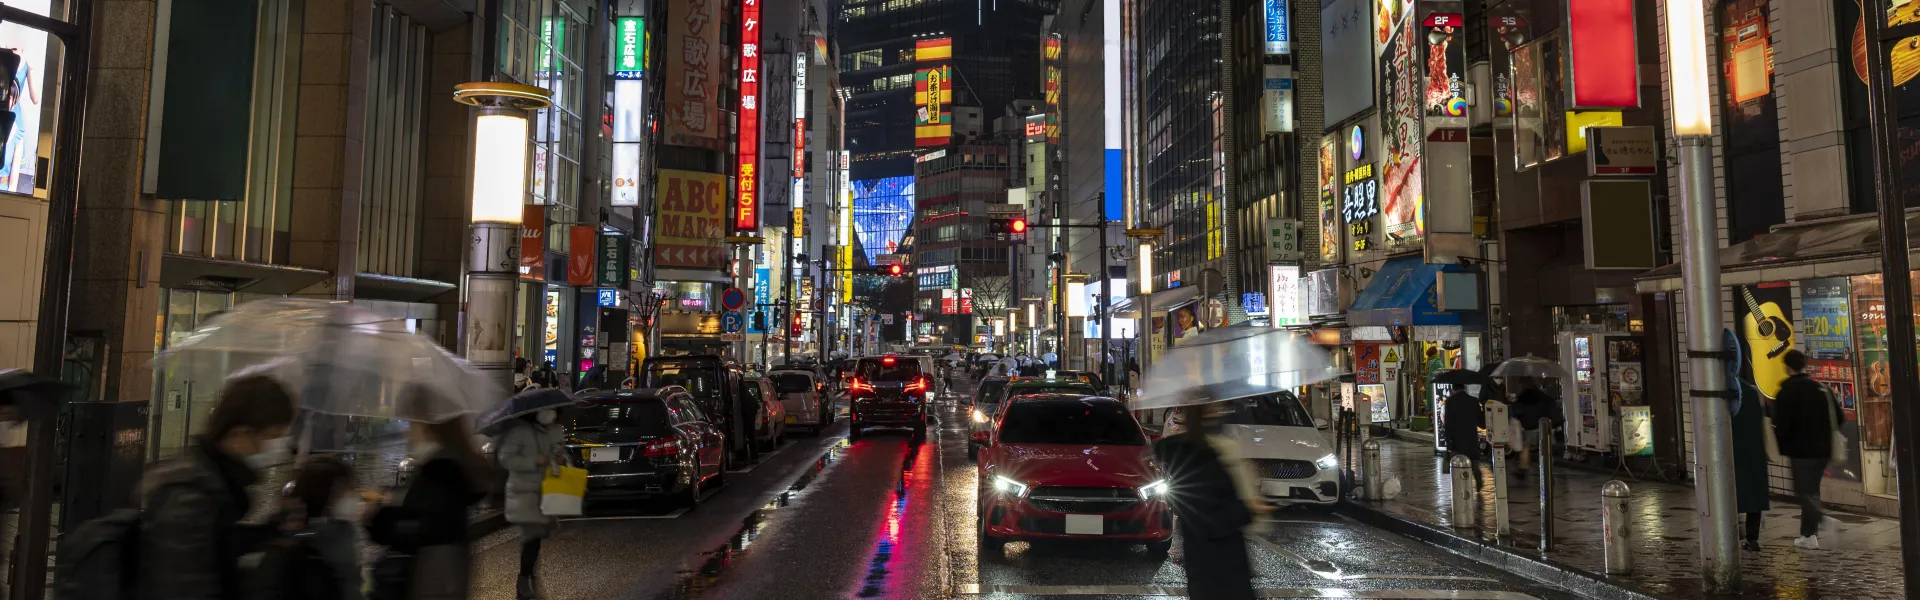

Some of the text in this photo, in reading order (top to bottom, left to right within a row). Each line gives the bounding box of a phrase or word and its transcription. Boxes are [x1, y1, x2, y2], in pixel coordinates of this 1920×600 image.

[1434, 16, 1449, 25] 2F
[683, 0, 709, 132] ケ歌広場
[1026, 122, 1046, 136] ビッ
[662, 177, 720, 213] ABC
[740, 163, 754, 221] 受付5F
[662, 214, 720, 238] MART
[1272, 228, 1281, 249] 眼科
[1284, 222, 1293, 251] なかの
[606, 237, 618, 282] 宝石広場
[726, 317, 735, 331] P
